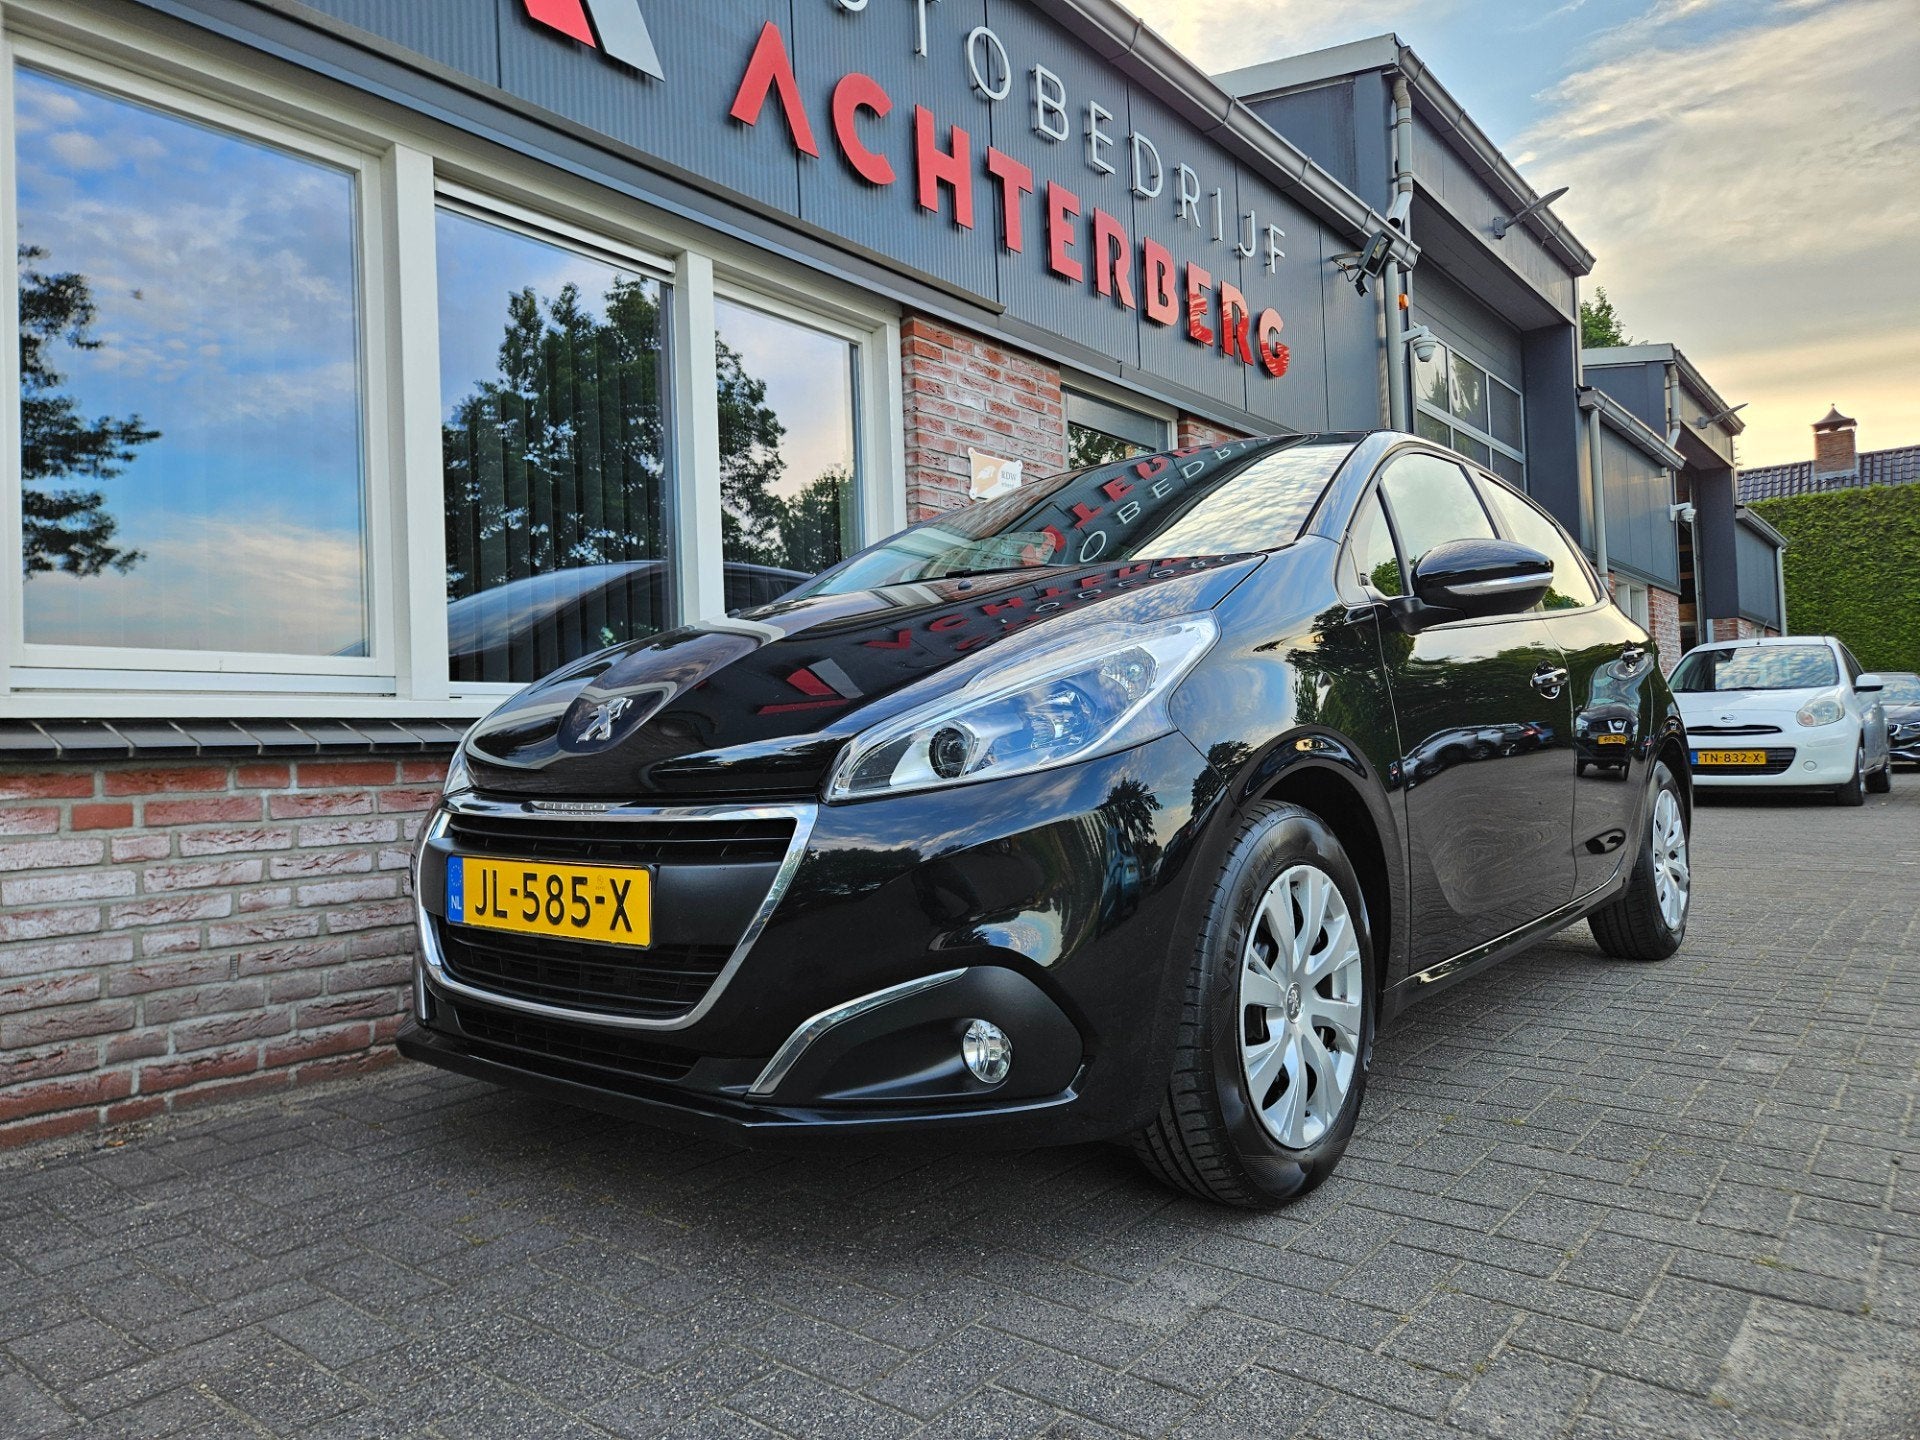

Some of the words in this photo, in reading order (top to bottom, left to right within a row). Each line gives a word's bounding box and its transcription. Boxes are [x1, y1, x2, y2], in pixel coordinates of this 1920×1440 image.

[730, 20, 1290, 377] ACHTERBERG
[838, 0, 1286, 274] OBEDRIJF
[1702, 753, 1760, 763] TN-832-X
[450, 895, 462, 910] NL
[475, 869, 632, 932] JL-585-X
